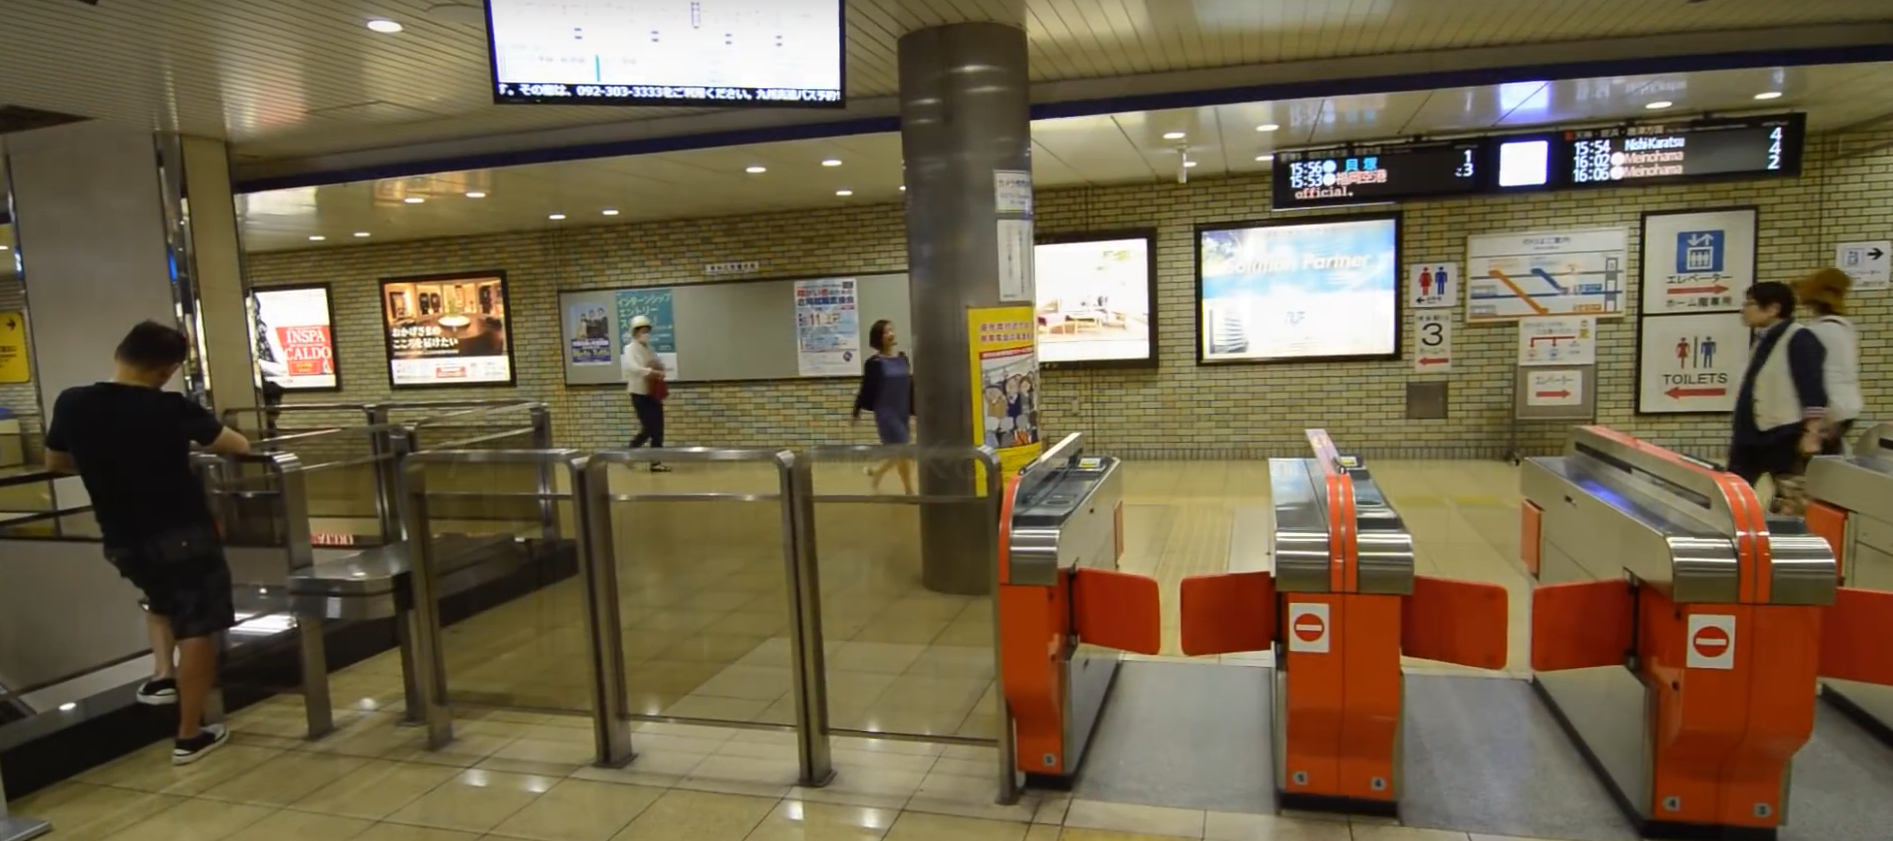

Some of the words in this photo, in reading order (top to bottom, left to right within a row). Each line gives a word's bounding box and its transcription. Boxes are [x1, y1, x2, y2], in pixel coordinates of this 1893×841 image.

[1574, 139, 1611, 155] 15:54
[1770, 126, 1782, 139] 4
[1290, 161, 1322, 175] 15:56
[1464, 149, 1472, 162] 1
[1573, 153, 1610, 168] 16:02
[1769, 141, 1781, 154] 4
[1573, 166, 1610, 181] 16:06
[1768, 155, 1780, 170] 2
[1290, 175, 1322, 188] 15:53
[1294, 187, 1354, 200] official.
[1302, 253, 1372, 270] Partner
[1666, 273, 1733, 285] エレベーター
[286, 329, 326, 344] INSPA
[1421, 322, 1443, 346] 3
[285, 346, 332, 361] CALDO
[1662, 372, 1729, 385] TOILETS
